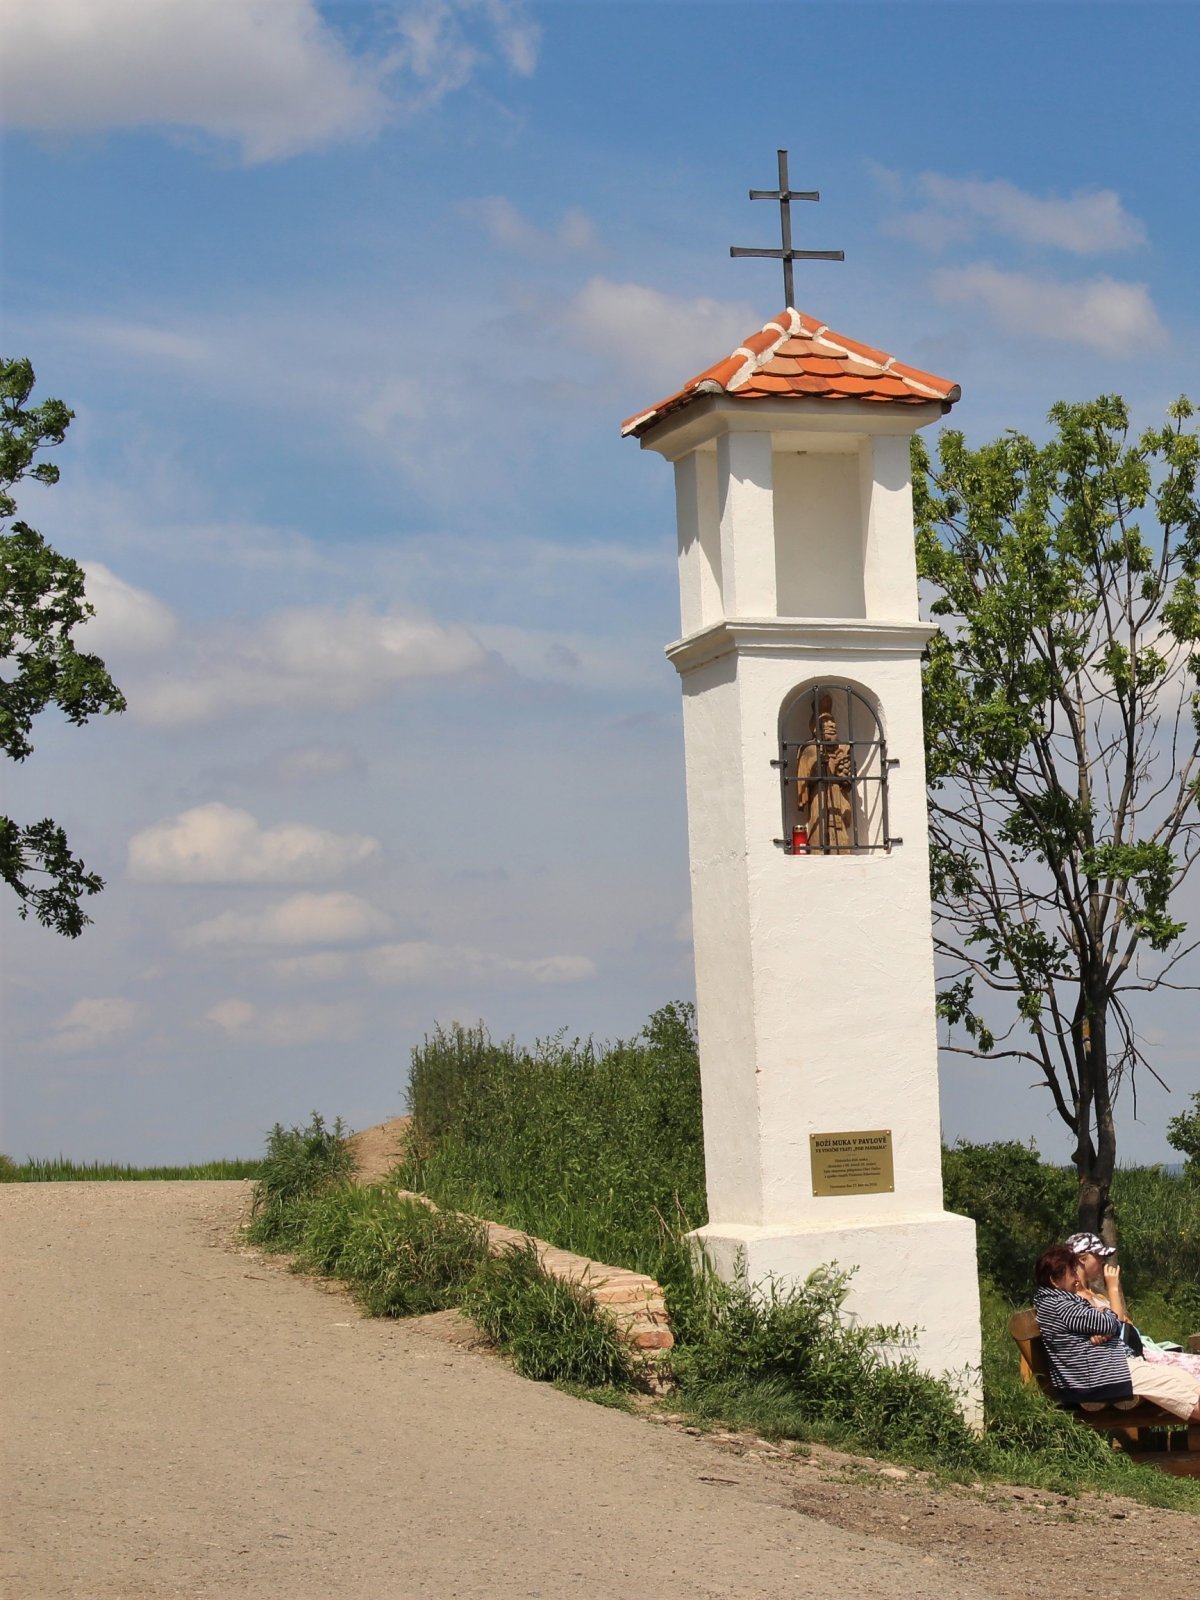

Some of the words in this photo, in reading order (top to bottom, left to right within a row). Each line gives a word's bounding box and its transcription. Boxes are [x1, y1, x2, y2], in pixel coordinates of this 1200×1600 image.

[816, 1139, 831, 1147] BOŽÍ
[833, 1139, 852, 1147] MUKA
[858, 1136, 887, 1145] PAVLOVĚ
